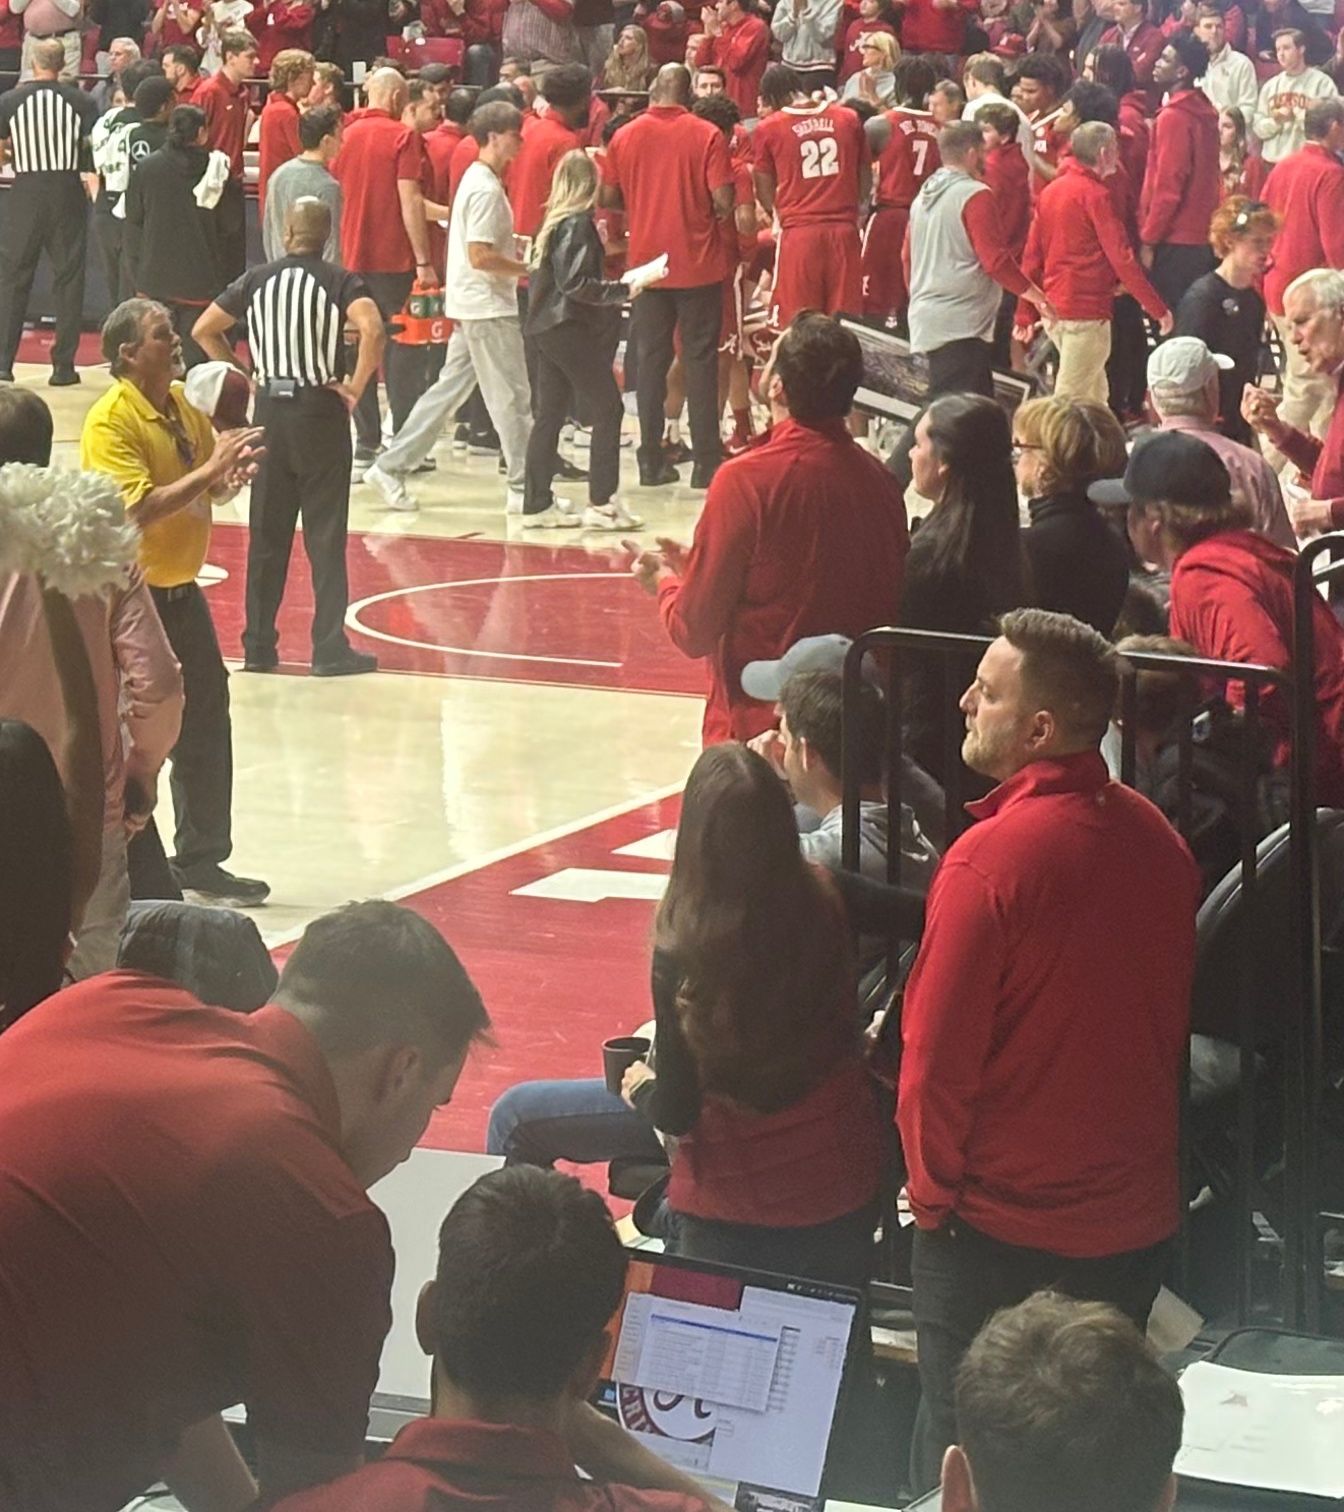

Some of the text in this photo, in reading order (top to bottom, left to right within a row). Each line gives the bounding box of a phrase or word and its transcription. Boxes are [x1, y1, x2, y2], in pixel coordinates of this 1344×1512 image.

[799, 137, 840, 179] 22
[911, 139, 929, 176] 7
[430, 320, 444, 339] G
